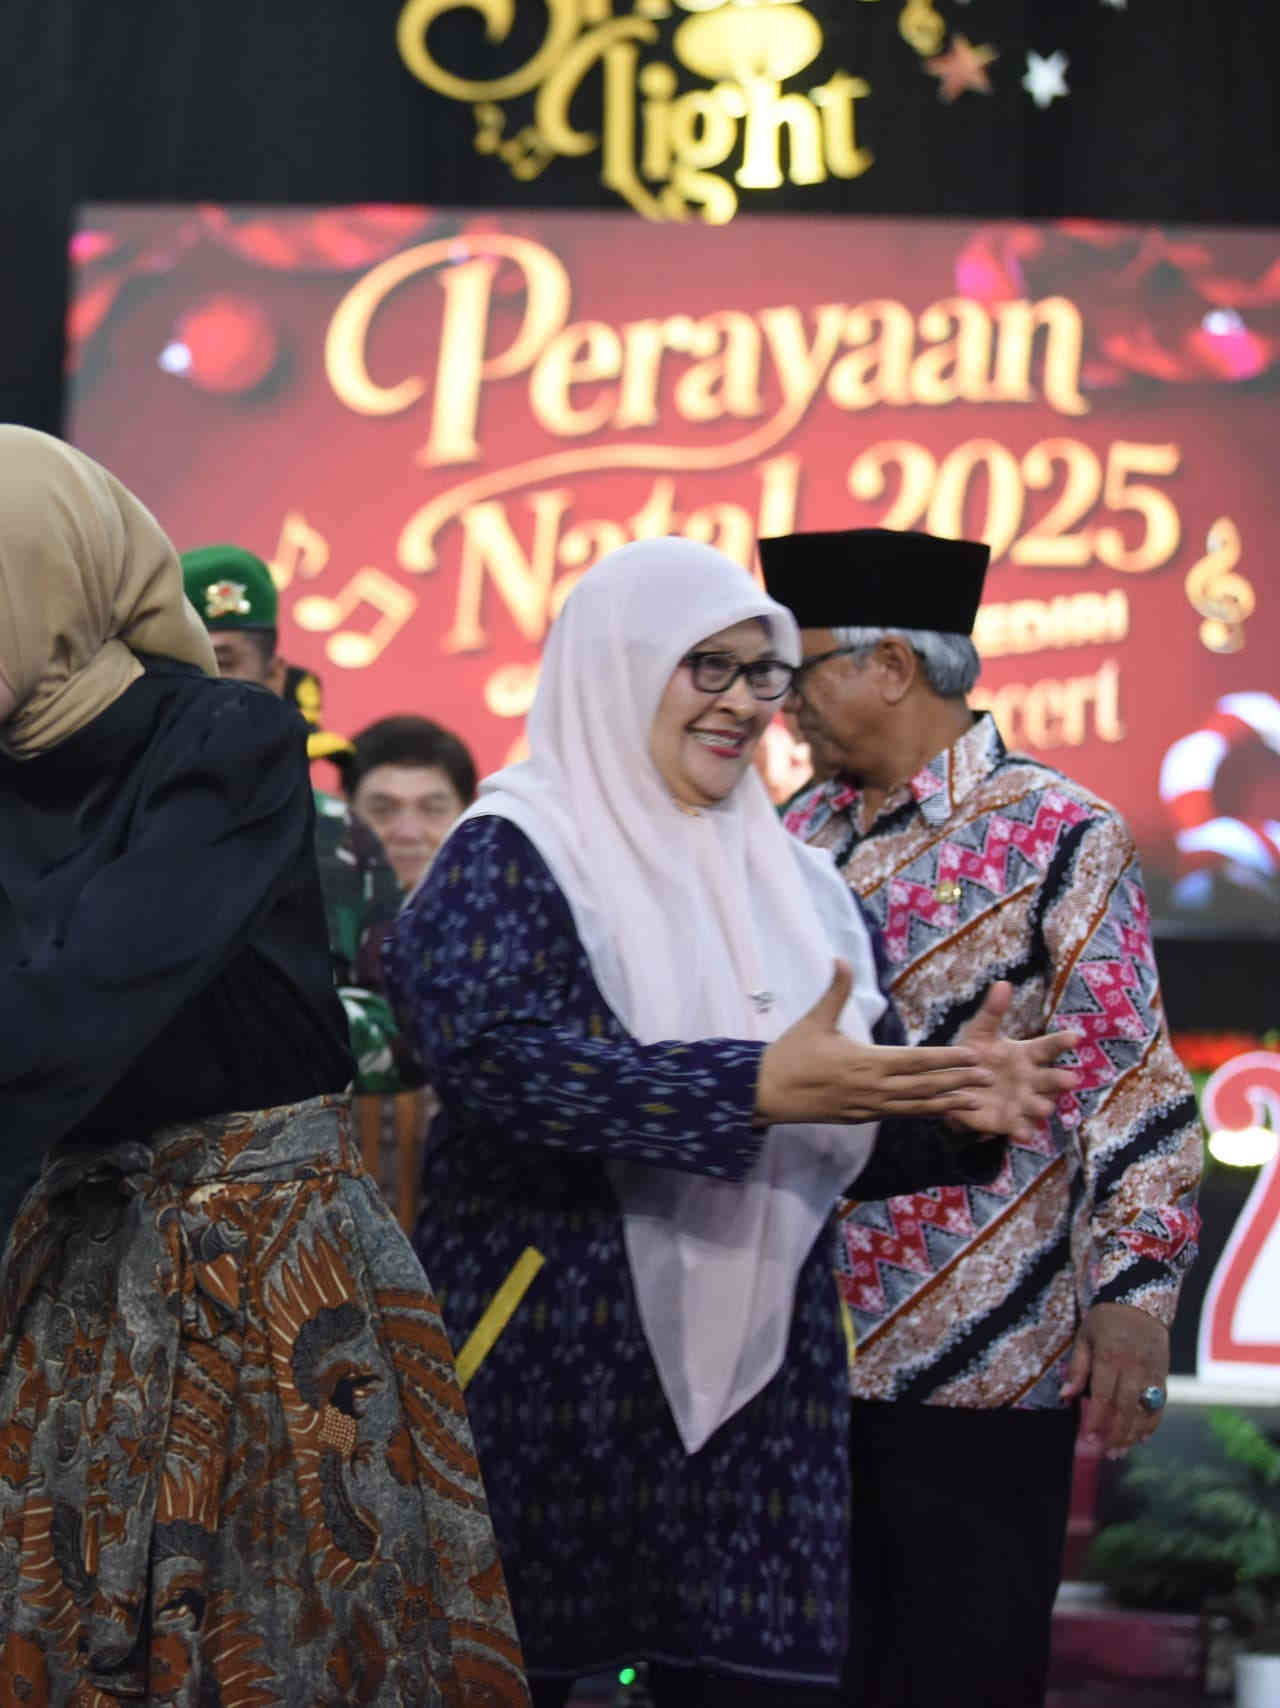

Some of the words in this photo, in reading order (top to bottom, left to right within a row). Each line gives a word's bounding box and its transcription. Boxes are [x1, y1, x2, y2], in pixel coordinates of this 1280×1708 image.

[535, 15, 874, 226] Light
[325, 233, 1090, 470] Perayaan
[848, 437, 1182, 573] 2025
